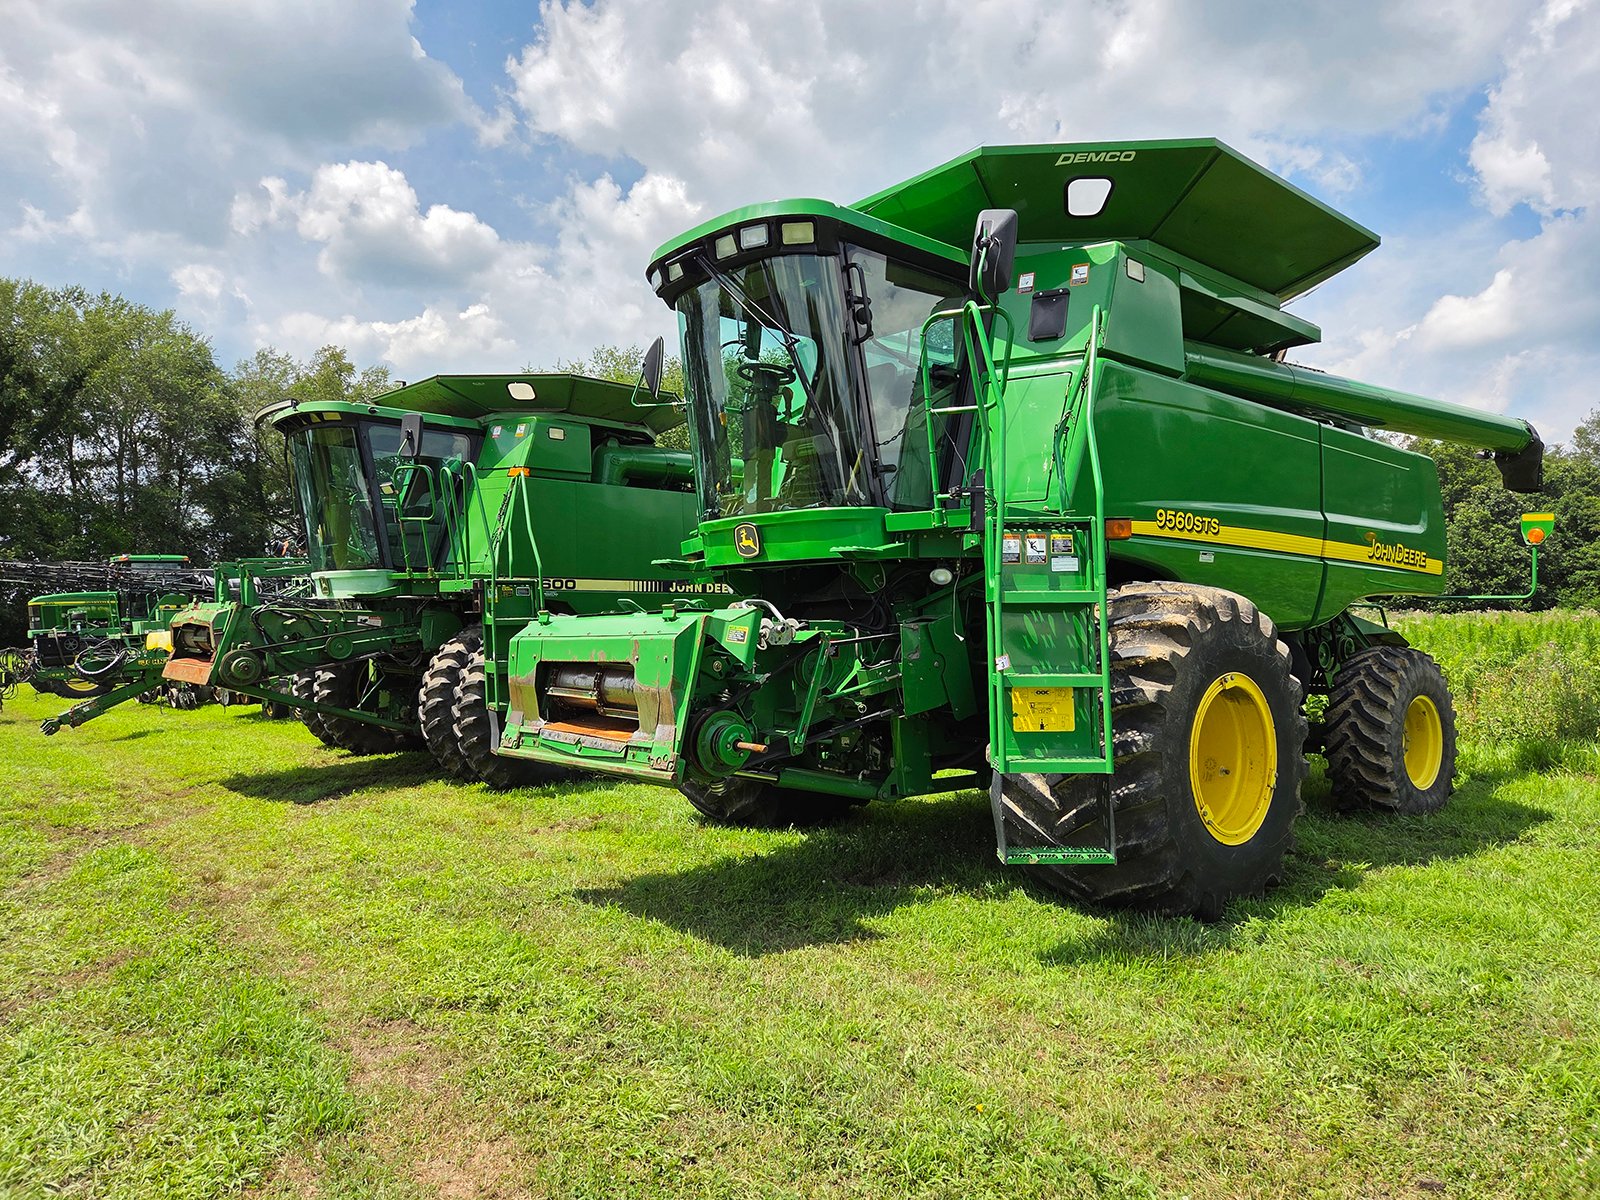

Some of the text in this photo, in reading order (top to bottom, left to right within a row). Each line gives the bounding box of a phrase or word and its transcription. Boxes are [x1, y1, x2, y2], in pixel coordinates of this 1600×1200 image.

[1054, 150, 1137, 167] DEMCO
[1156, 508, 1220, 535] 9560STS
[542, 579, 577, 590] 600
[669, 582, 729, 594] JOHN DEE
